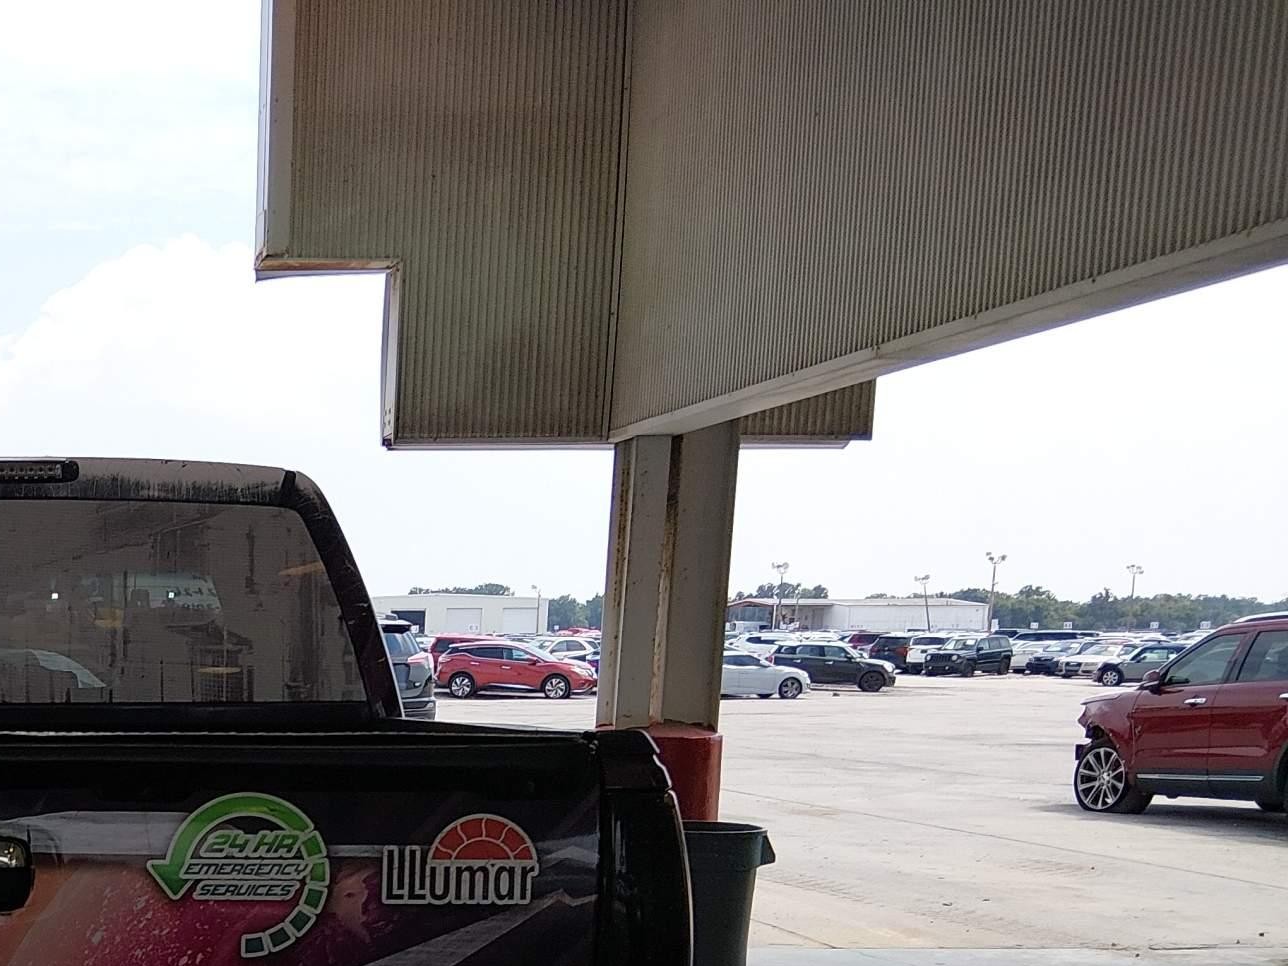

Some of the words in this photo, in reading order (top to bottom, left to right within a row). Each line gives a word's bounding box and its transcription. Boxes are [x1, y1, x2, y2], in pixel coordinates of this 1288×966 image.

[202, 831, 250, 856] 24
[251, 831, 301, 857] HR
[182, 861, 310, 877] EMERGENCY
[198, 883, 297, 898] SERVICES
